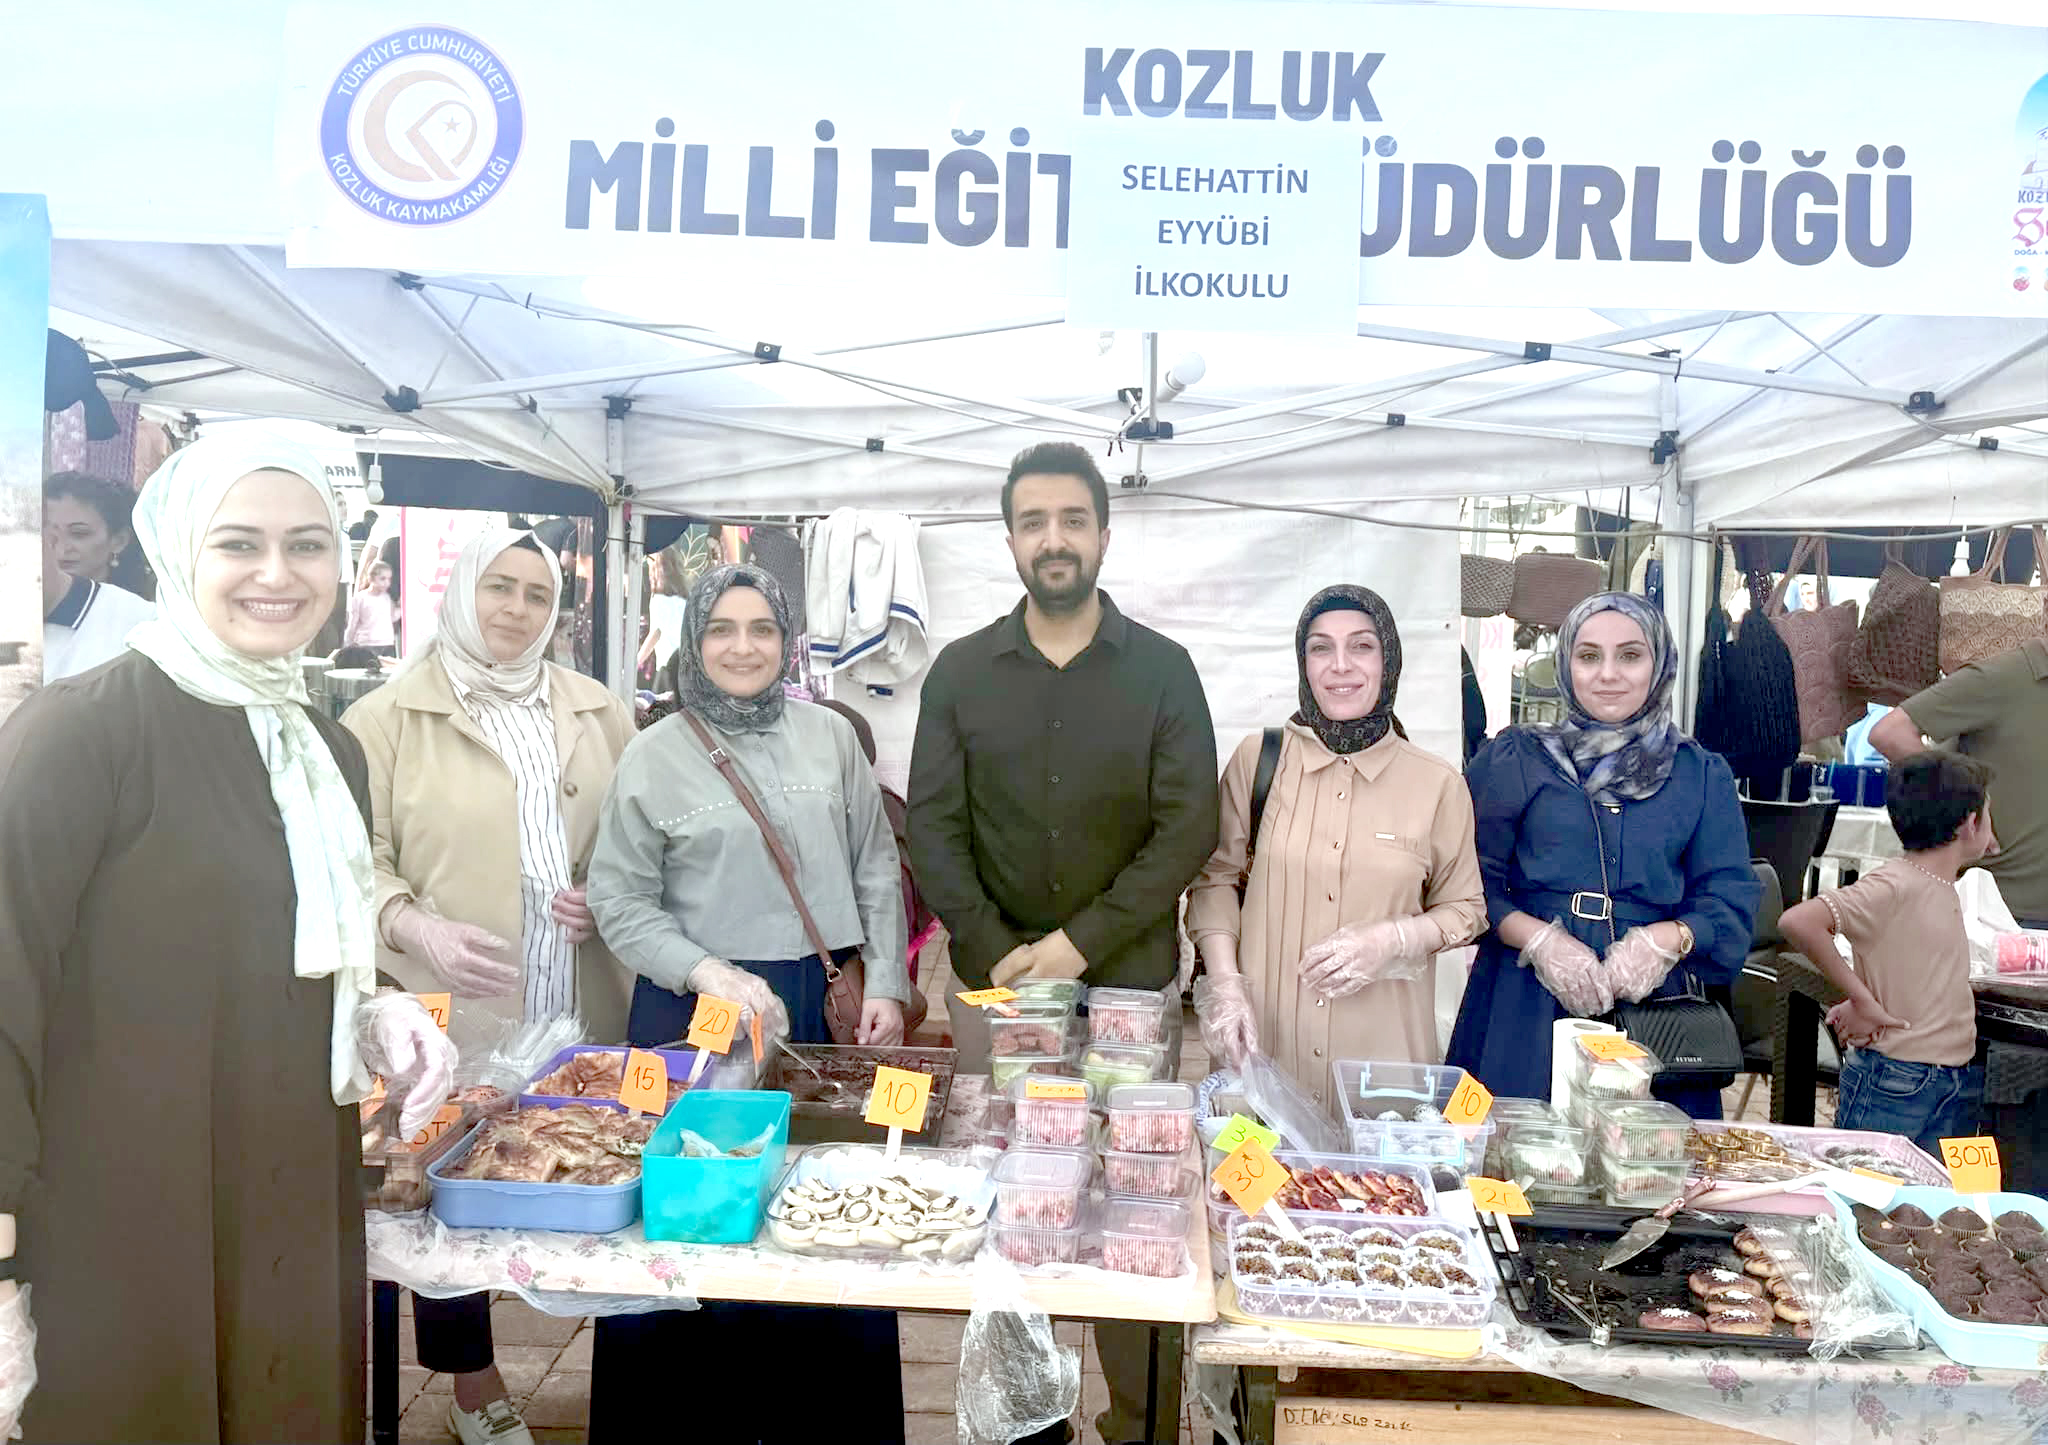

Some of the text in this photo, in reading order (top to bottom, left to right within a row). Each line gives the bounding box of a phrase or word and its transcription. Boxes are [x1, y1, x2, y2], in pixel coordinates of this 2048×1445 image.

[337, 33, 515, 103] TÜRKİYE CUMHURİYETİ
[1083, 47, 1386, 122] KOZLUK
[330, 152, 510, 221] KOZLUK KAYMAKAMLIĞI
[566, 118, 1911, 268] MİLLİ EĞİT ÜDÜRLÜĞÜ
[1122, 163, 1308, 193] SELEHATTİN
[2017, 190, 2048, 203] KOZ
[1158, 215, 1269, 246] EYYÜBİ
[1136, 265, 1289, 298] İLKOKULU
[698, 1007, 730, 1035] 20
[633, 1066, 655, 1091] 15
[883, 1080, 917, 1115] 10
[1461, 1084, 1481, 1117] 10
[1229, 1153, 1265, 1192] 30
[1948, 1145, 1998, 1168] 30TL
